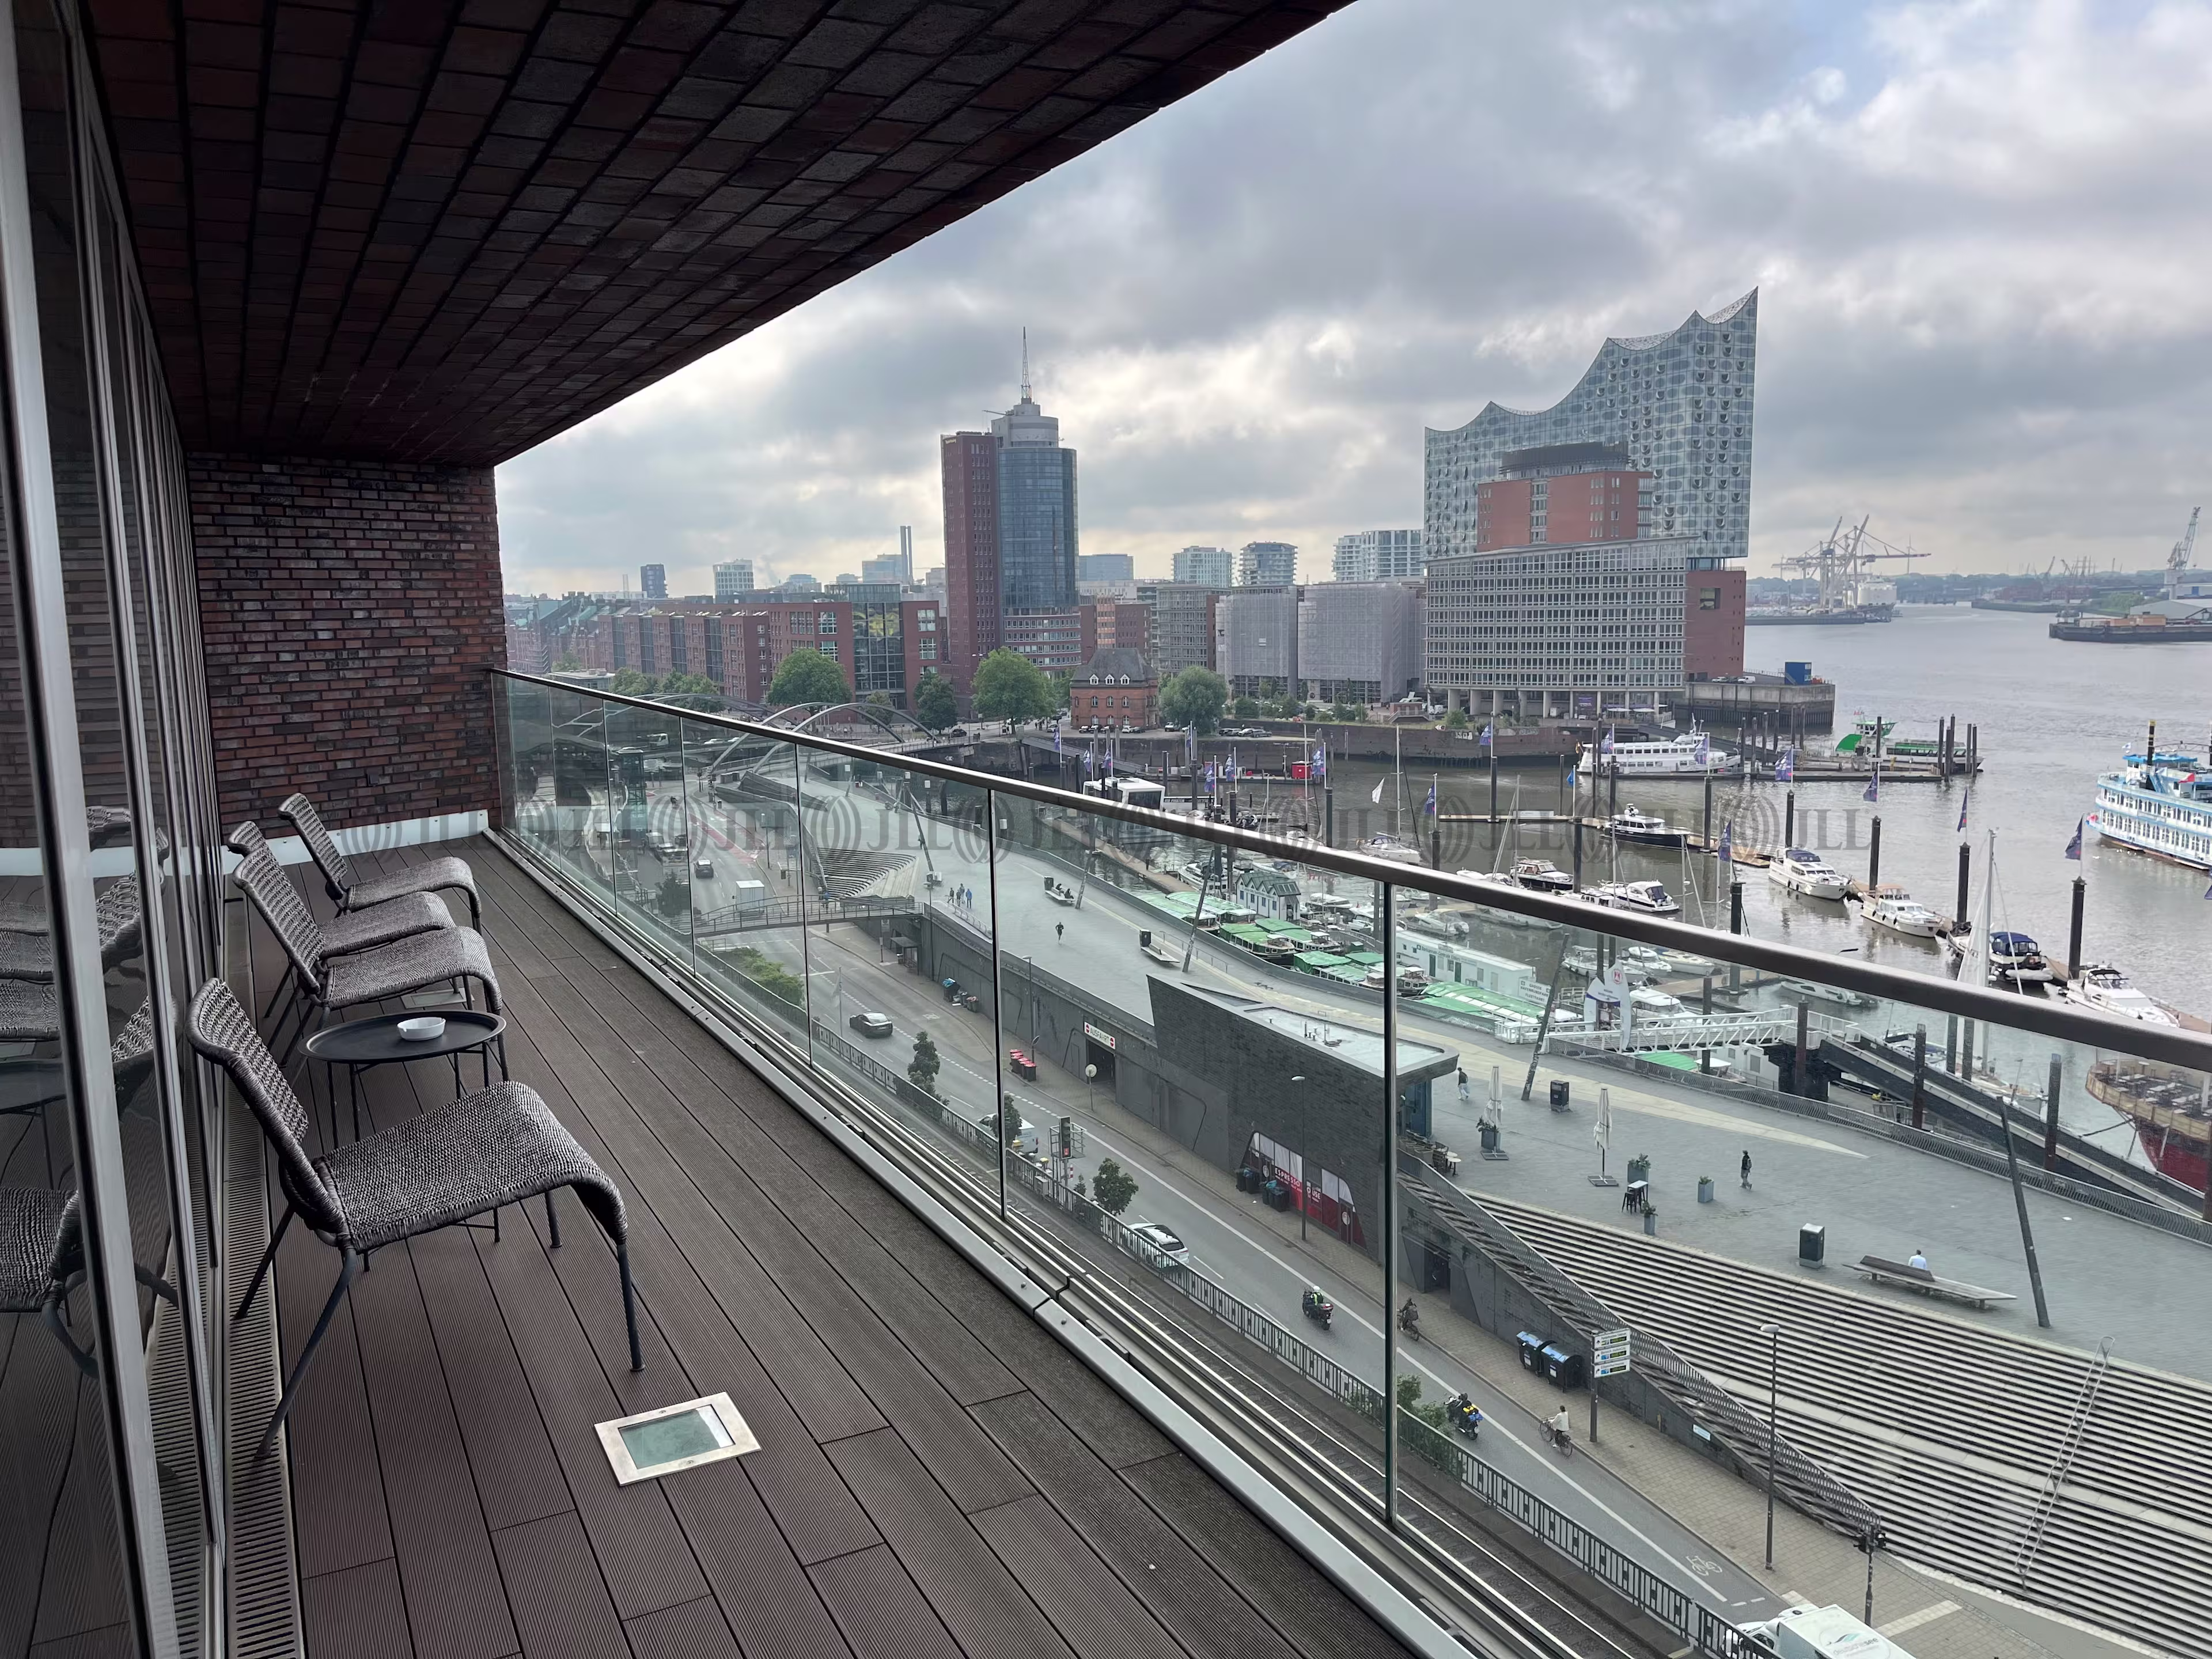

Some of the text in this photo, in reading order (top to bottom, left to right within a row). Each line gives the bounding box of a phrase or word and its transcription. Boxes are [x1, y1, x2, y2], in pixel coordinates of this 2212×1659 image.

[1090, 1027, 1109, 1044] AUSFAHRT
[1275, 1167, 1301, 1187] ESPRESSO
[1304, 1185, 1321, 1199] OUSE
